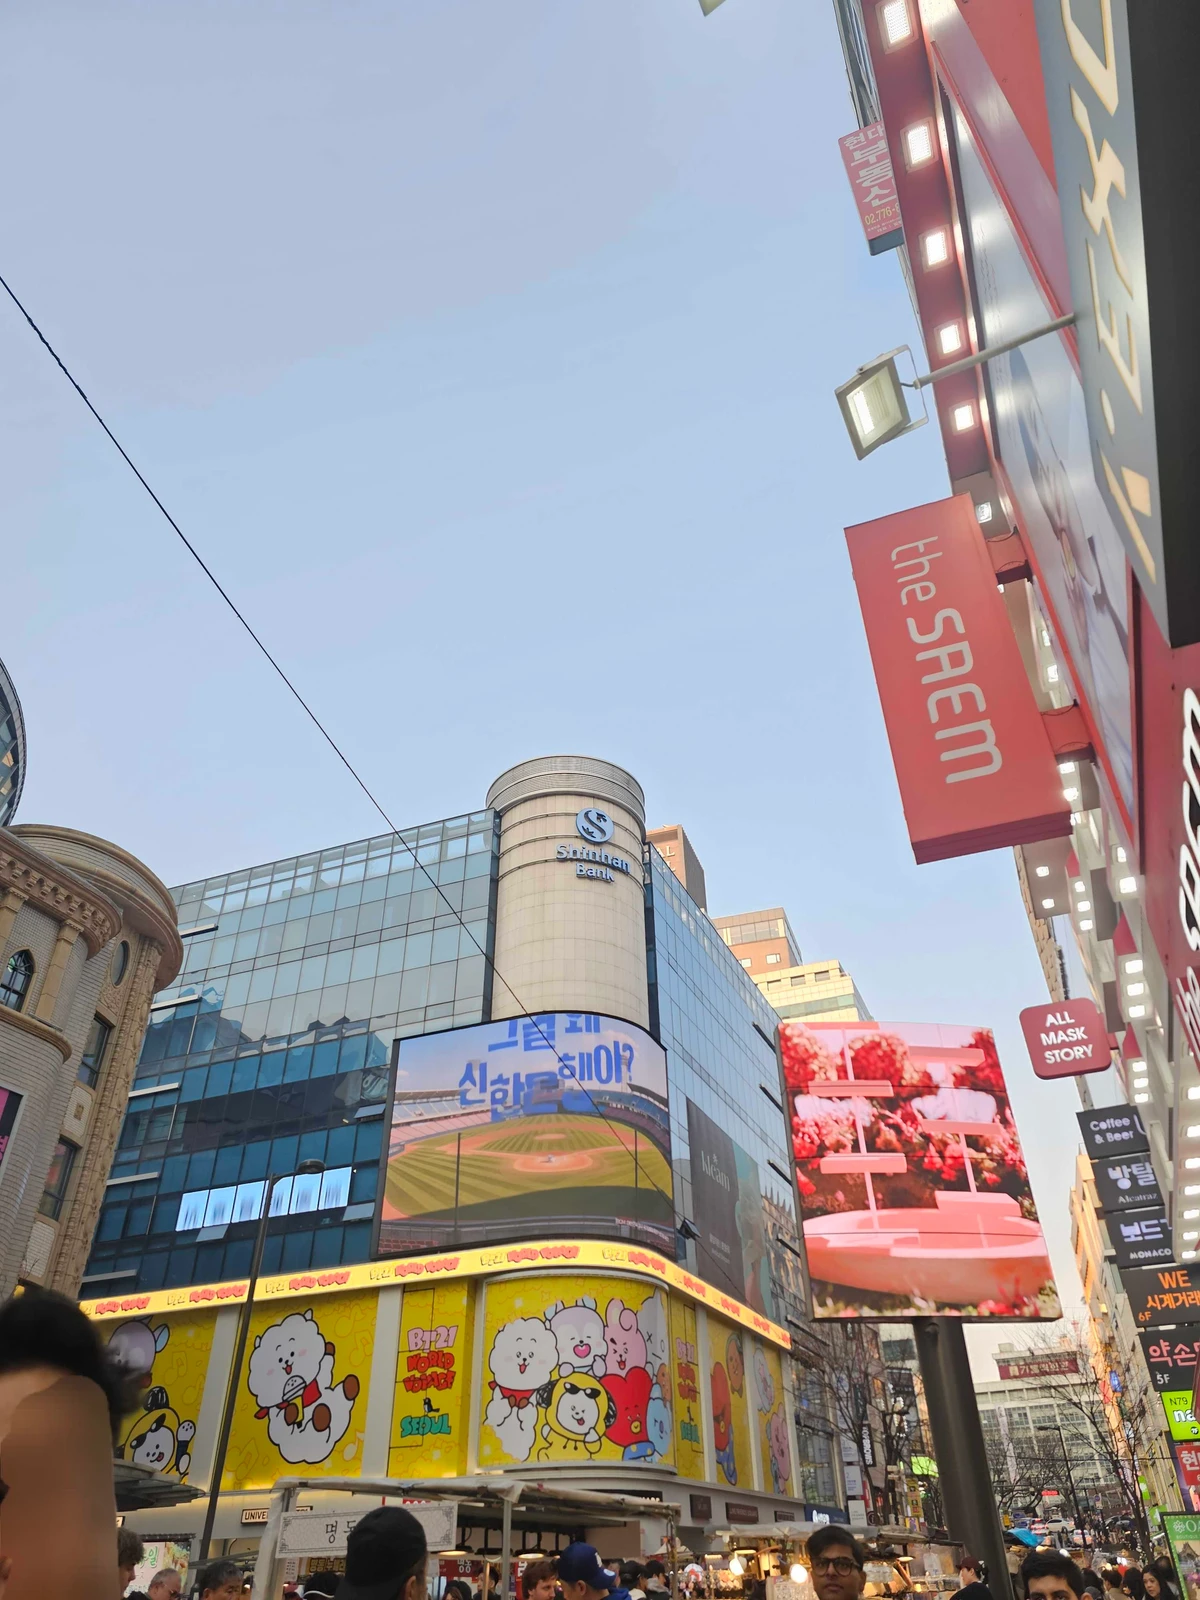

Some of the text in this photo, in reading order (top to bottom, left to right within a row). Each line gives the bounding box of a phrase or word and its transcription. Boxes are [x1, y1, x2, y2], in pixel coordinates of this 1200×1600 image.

[890, 535, 943, 606] the
[555, 843, 631, 874] Shinhan
[575, 862, 614, 883] Bank
[1045, 1010, 1076, 1028] ALL
[1040, 1026, 1088, 1046] MASK
[1044, 1043, 1093, 1064] STORY
[1089, 1117, 1131, 1131] Coffee
[1094, 1130, 1135, 1145] & Beer
[1129, 1247, 1172, 1260] MONACO
[1157, 1269, 1192, 1290] WE
[1138, 1311, 1152, 1322] 6F
[406, 1325, 459, 1353] BT21
[406, 1350, 455, 1373] WORLD
[402, 1369, 456, 1393] VOYAGE
[1156, 1373, 1171, 1385] 5F
[1169, 1396, 1189, 1406] N79
[400, 1413, 452, 1439] SEOUL
[244, 1510, 267, 1521] UNIVE
[1186, 1519, 1200, 1533] O
